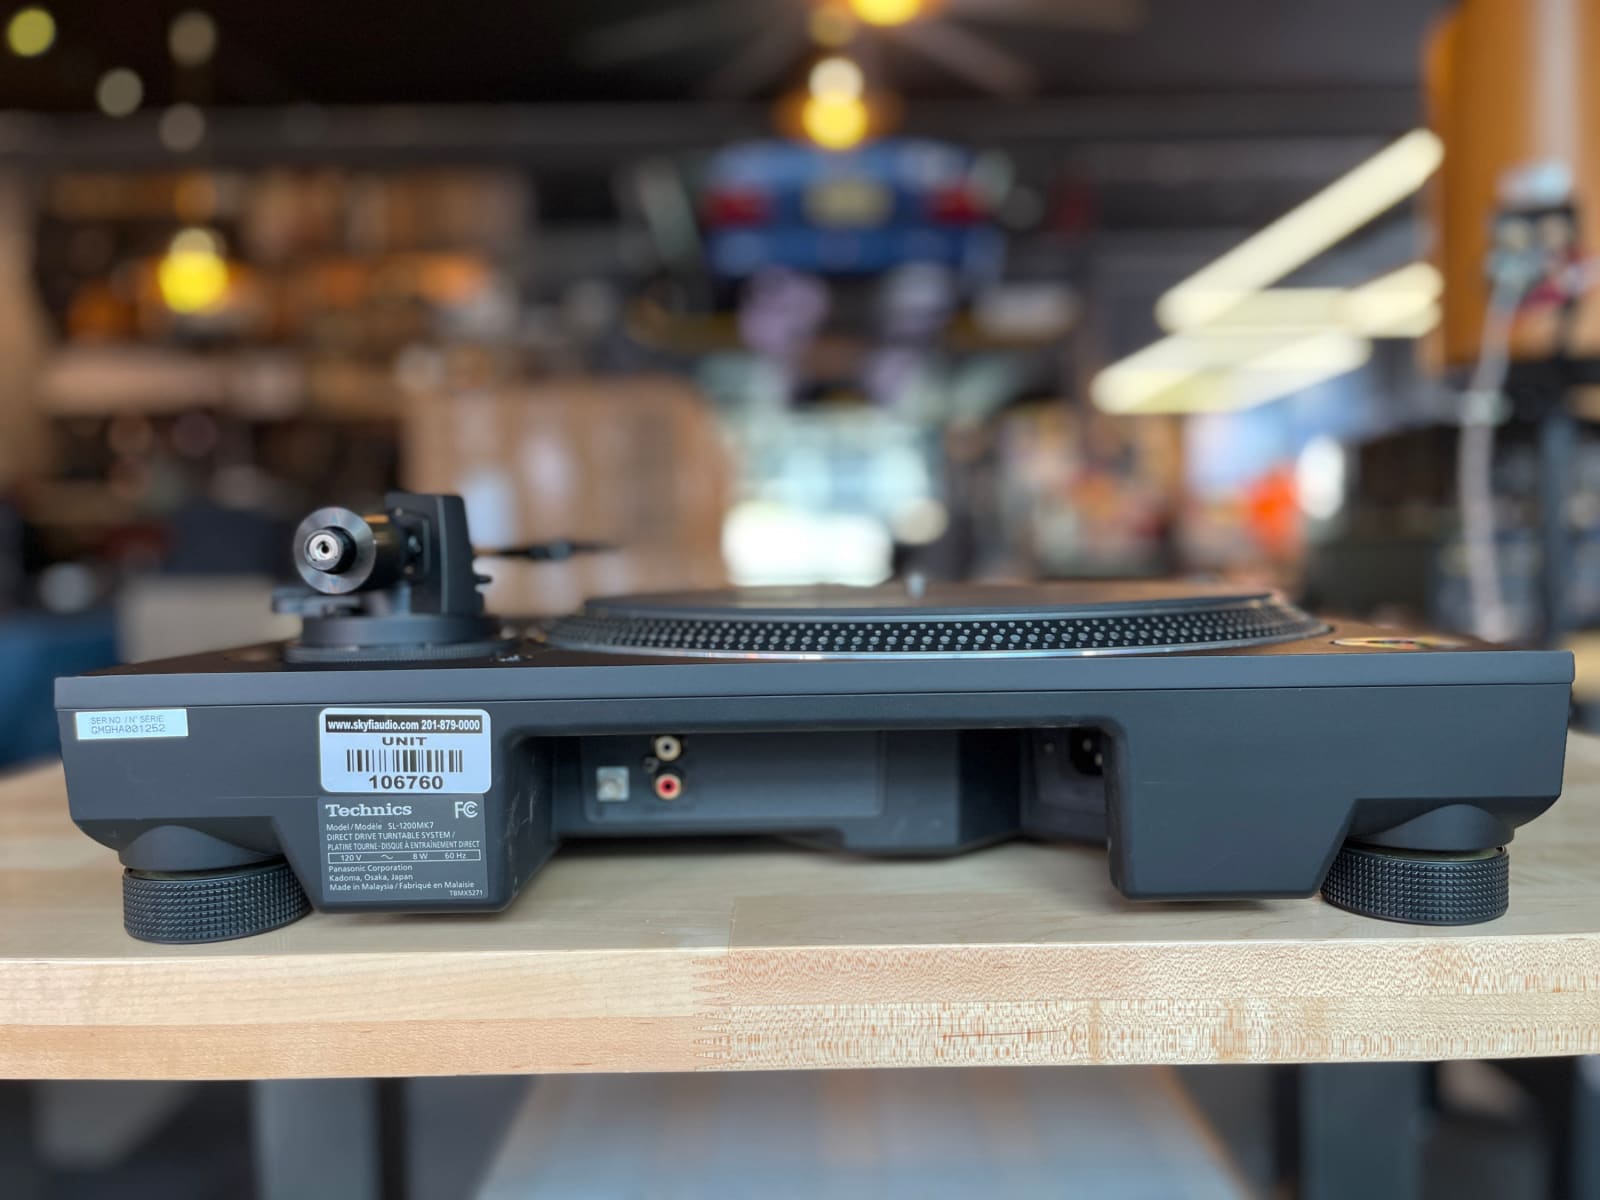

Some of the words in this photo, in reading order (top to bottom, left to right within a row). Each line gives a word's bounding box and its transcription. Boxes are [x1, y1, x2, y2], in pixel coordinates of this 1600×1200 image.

[328, 719, 419, 731] www.skyfiaudio.com
[421, 720, 480, 730] 201-879-0000
[382, 737, 427, 746] UNIT
[369, 775, 443, 789] 106760
[325, 803, 412, 817] Technics
[421, 831, 451, 839] SYSTEM
[459, 840, 480, 848] DIRECT
[367, 864, 412, 872] Corporation
[391, 873, 413, 881] Japan
[330, 883, 351, 891] Made
